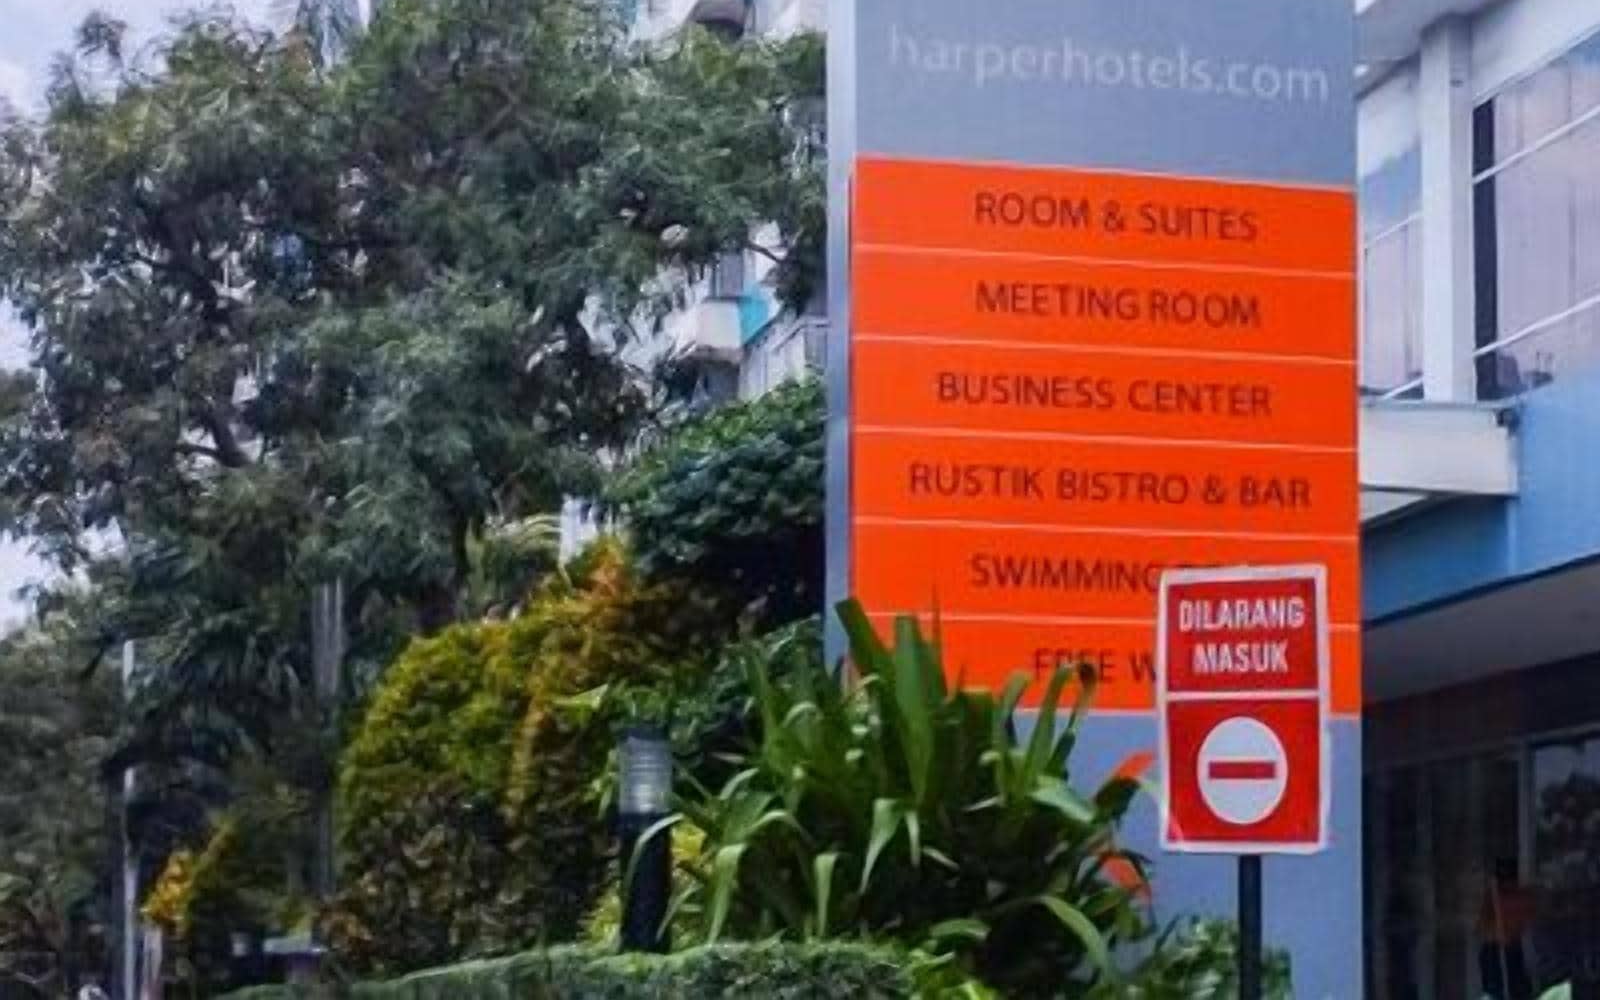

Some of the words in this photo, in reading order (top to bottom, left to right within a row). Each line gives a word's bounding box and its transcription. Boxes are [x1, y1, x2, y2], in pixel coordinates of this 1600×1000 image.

[889, 24, 1329, 103] harperhotels.com
[974, 192, 1090, 229] ROOM
[1103, 201, 1126, 233] &
[1139, 203, 1259, 242] SUITES
[974, 280, 1141, 321] MEETING
[1150, 291, 1262, 329] ROOM
[936, 372, 1115, 409] BUSINESS
[1127, 379, 1273, 417] CENTER
[910, 464, 1044, 500] RUSTIK
[1056, 468, 1189, 505] BISTRO
[1203, 473, 1226, 505] &
[1240, 477, 1313, 509] BAR
[1178, 597, 1306, 633] DILARANG
[1192, 640, 1290, 675] MASUK
